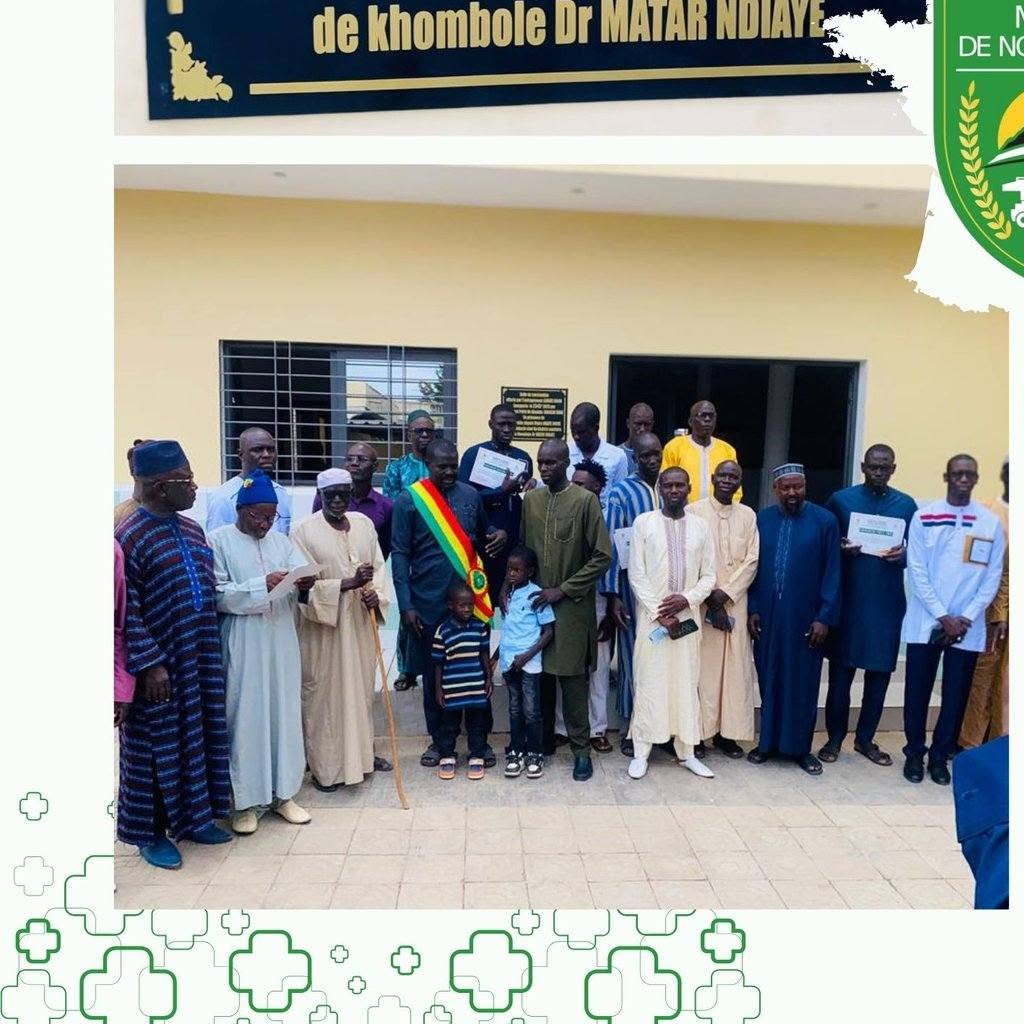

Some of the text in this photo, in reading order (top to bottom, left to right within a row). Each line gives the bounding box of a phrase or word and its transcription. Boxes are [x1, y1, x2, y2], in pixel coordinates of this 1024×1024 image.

[313, 7, 358, 54] de
[368, 1, 545, 51] khombole
[556, 0, 592, 44] Dr
